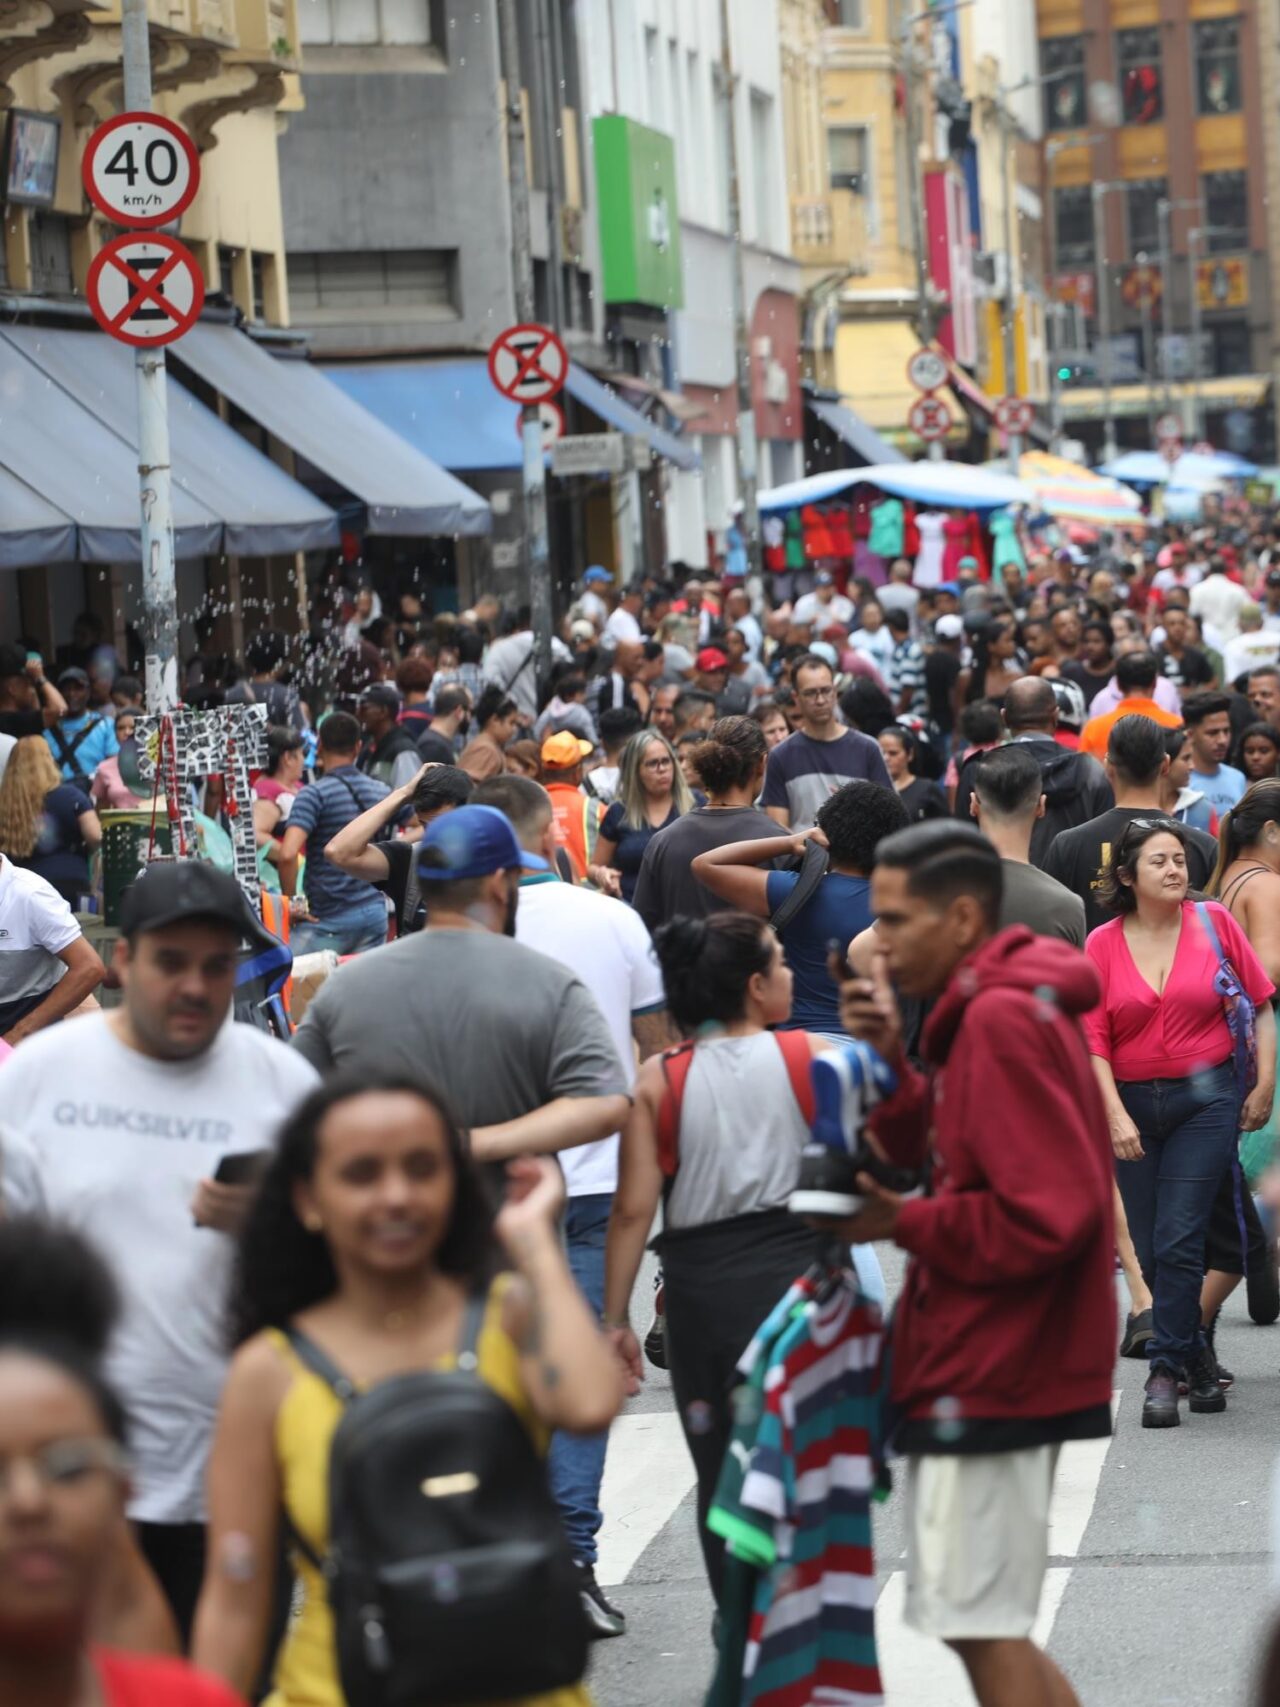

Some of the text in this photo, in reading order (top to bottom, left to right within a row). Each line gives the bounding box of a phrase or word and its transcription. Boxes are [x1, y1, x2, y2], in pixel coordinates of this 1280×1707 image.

[104, 139, 178, 186] 40
[123, 194, 162, 206] km/h
[53, 1100, 233, 1143] QUIKSILVER
